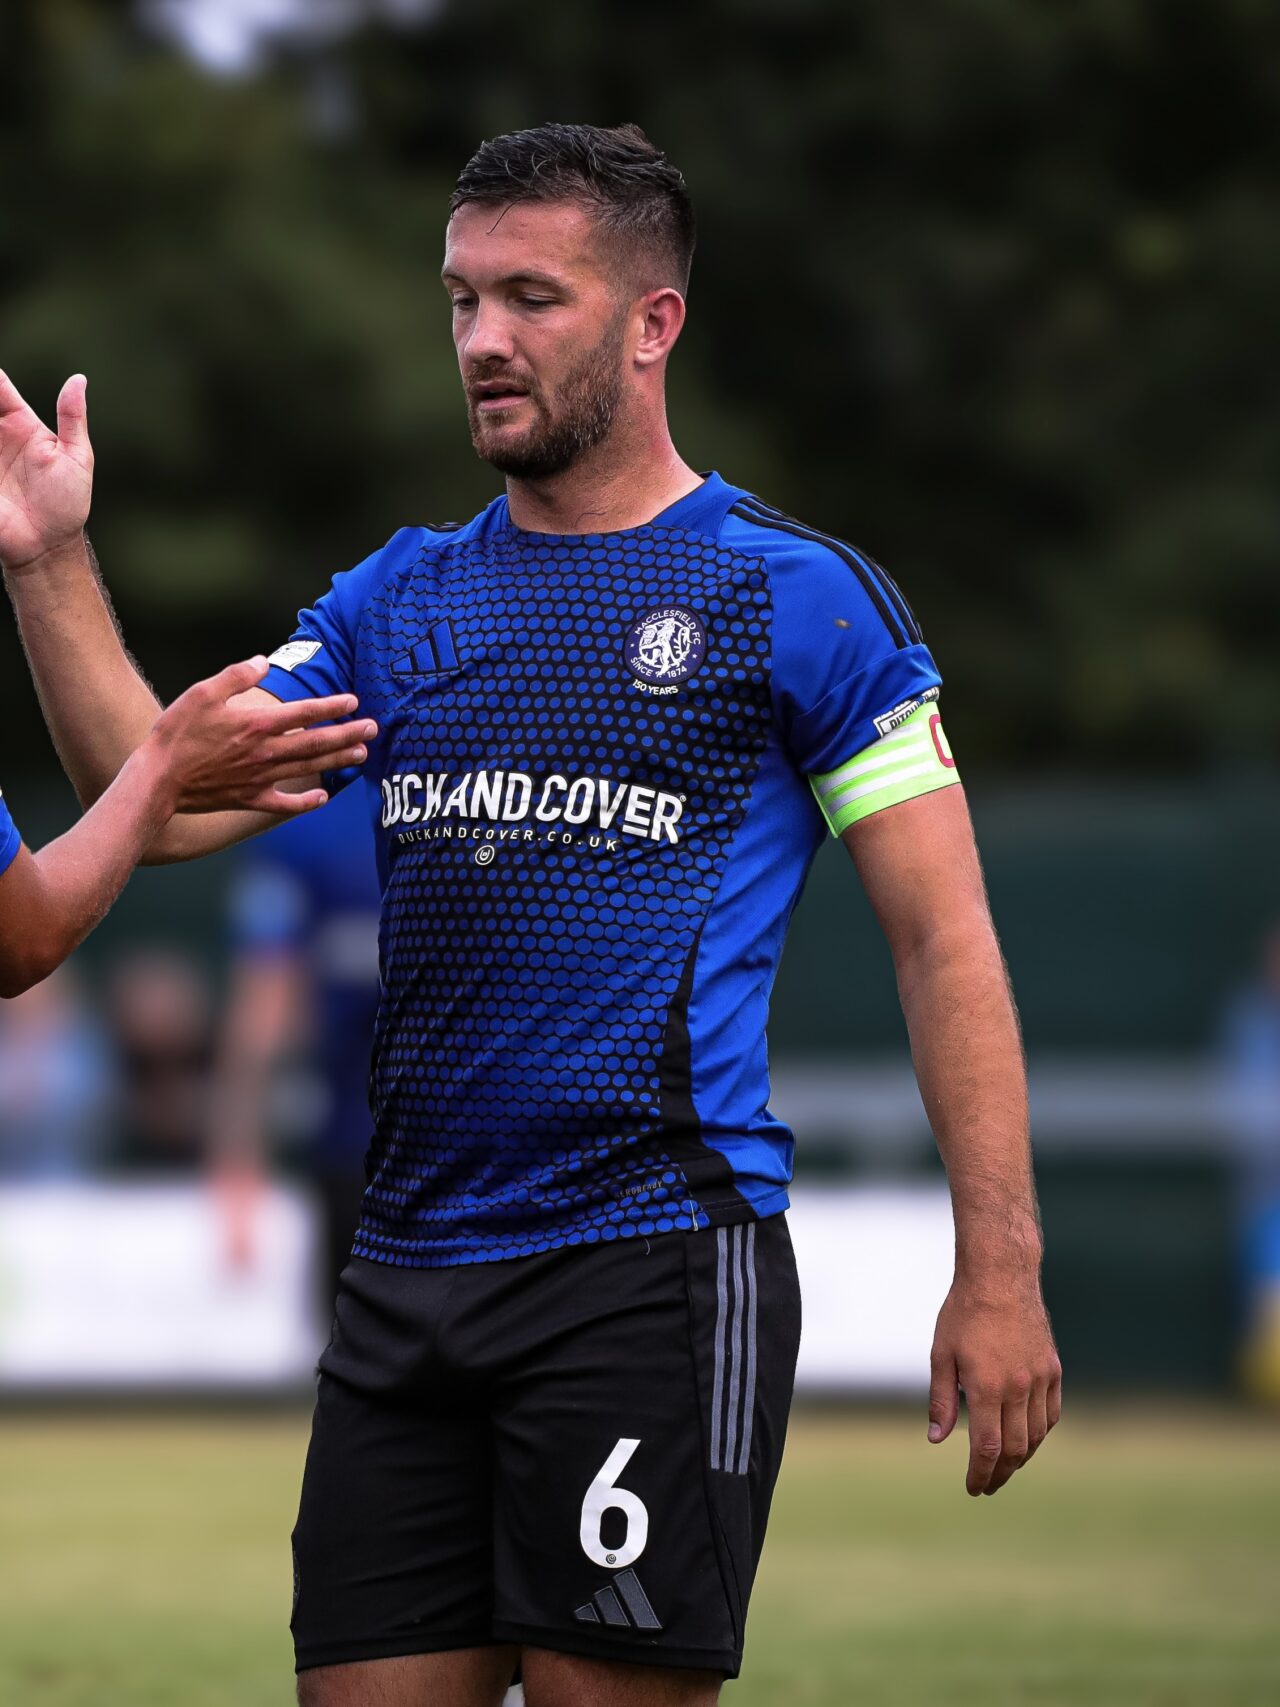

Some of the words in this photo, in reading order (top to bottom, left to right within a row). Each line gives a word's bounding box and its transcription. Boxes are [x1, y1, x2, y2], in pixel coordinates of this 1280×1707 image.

[635, 610, 696, 634] MACCLESFIELD
[691, 632, 701, 645] FC
[631, 657, 653, 676] SINCE
[667, 666, 688, 678] 1874
[632, 678, 648, 692] 150
[648, 685, 679, 696] YEARS
[535, 774, 685, 844] COVER
[579, 1437, 650, 1569] 6
